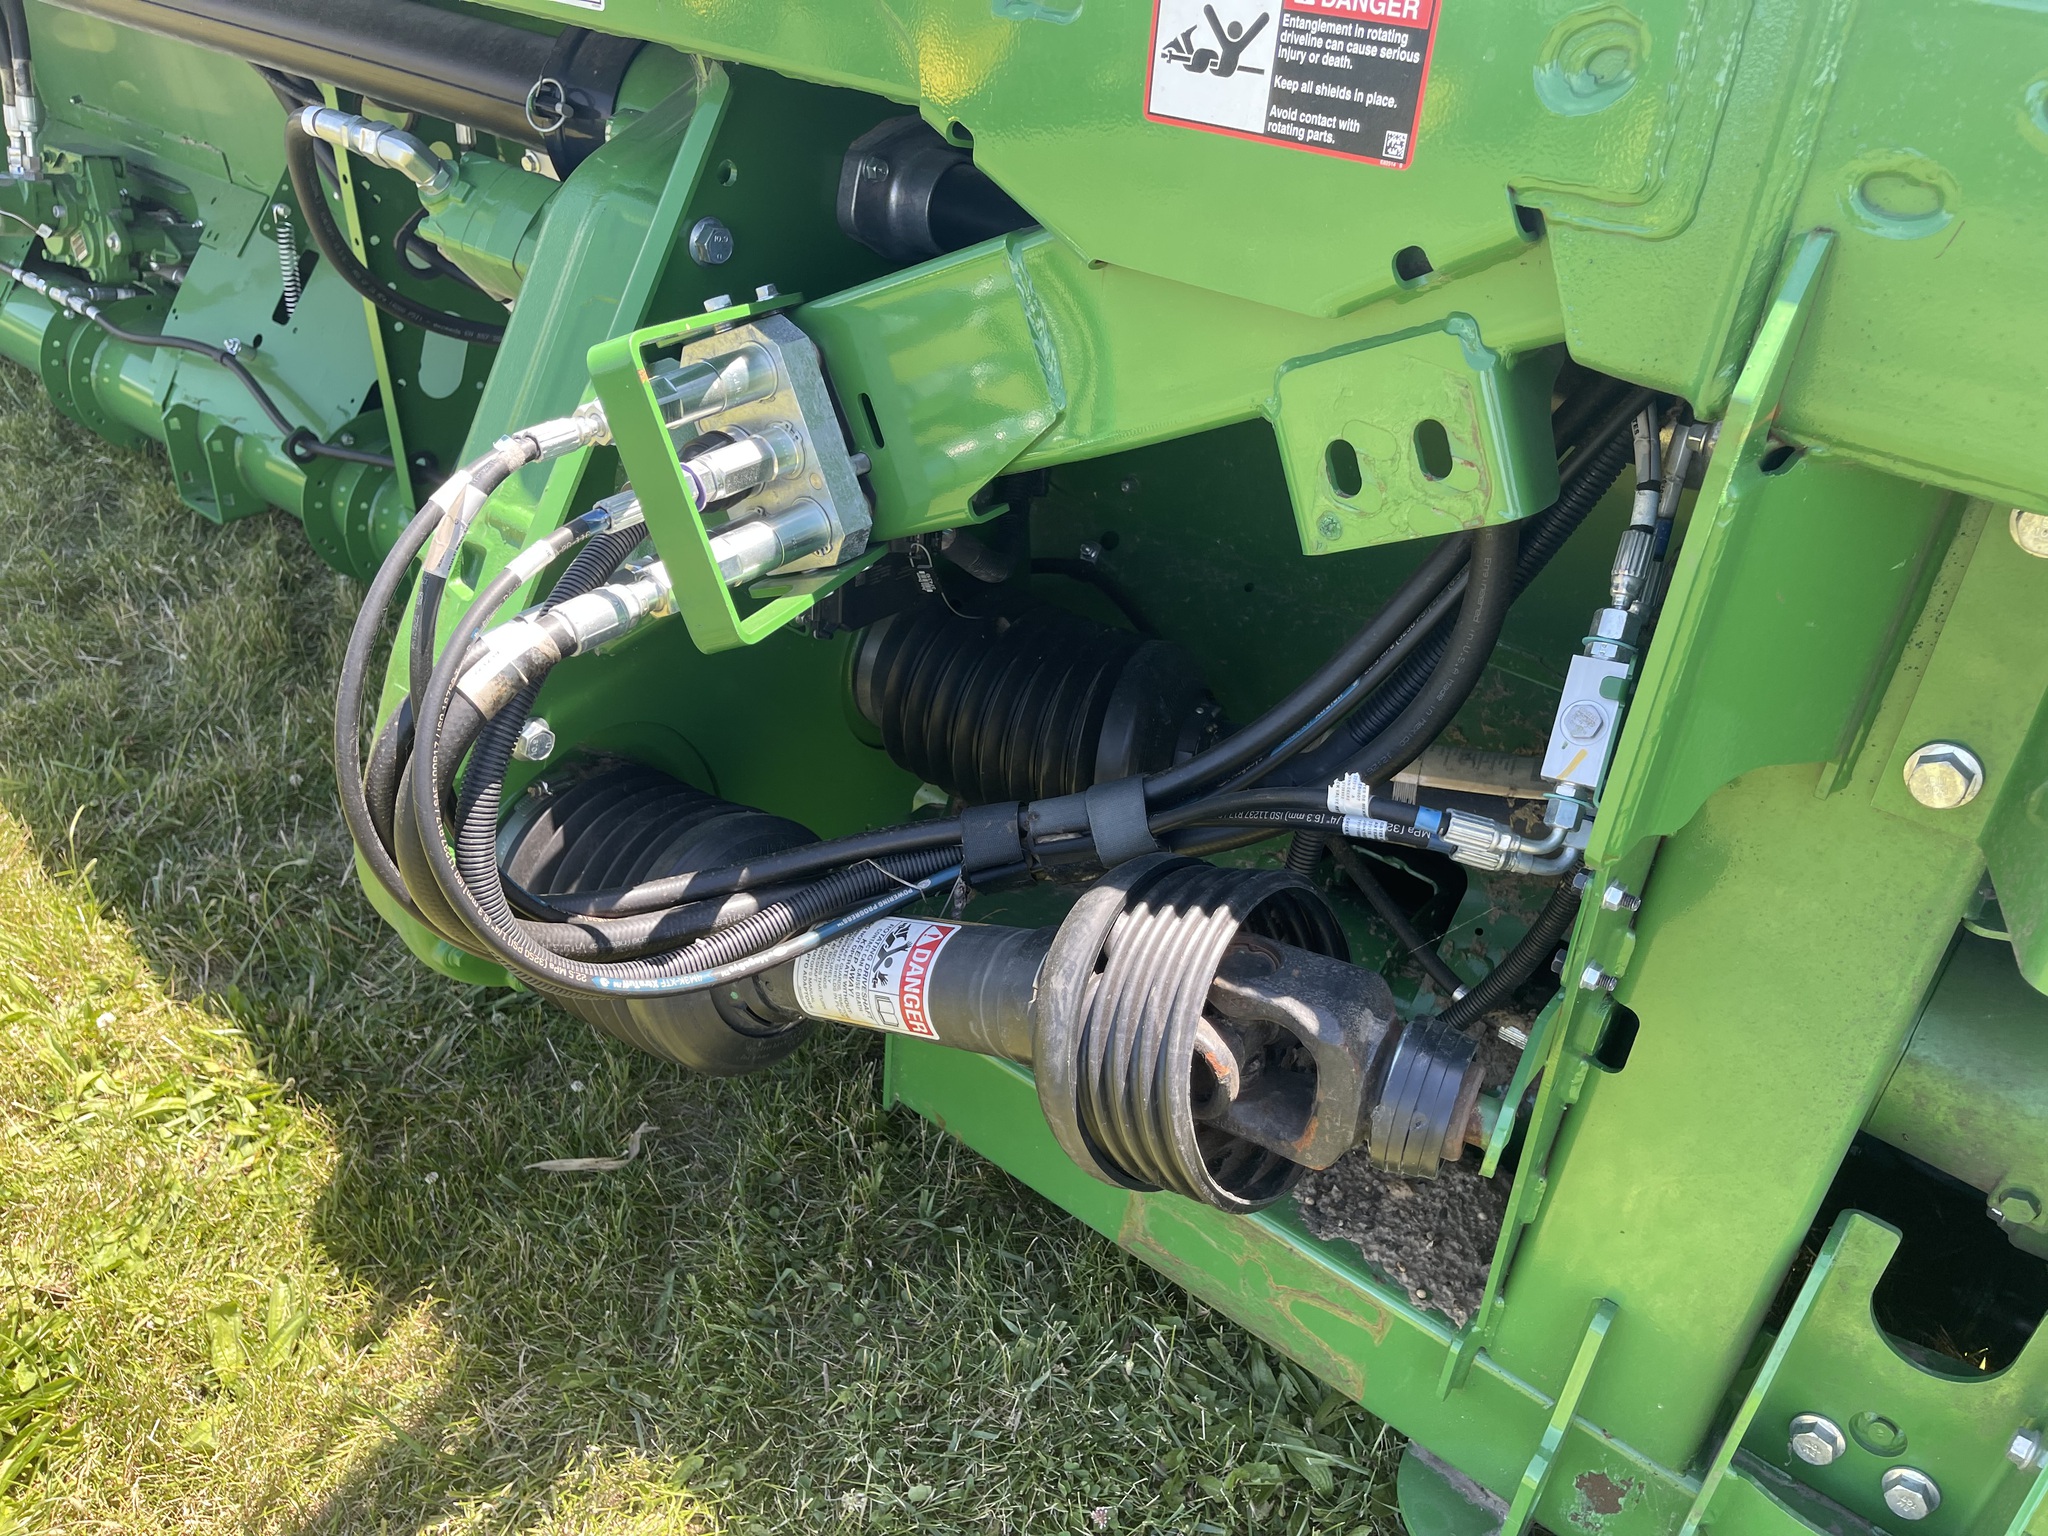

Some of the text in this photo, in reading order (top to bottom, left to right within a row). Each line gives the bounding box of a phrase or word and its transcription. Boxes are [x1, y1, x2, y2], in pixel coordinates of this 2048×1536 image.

[1282, 13, 1409, 48] Entanglement in rotating
[1278, 45, 1353, 70] injury or death.
[1280, 30, 1420, 64] driveline can cause serious
[1273, 75, 1398, 109] Keep all shields in place.
[1269, 104, 1361, 134] Avoid contact with
[1267, 121, 1336, 144] rotating parts.
[1244, 811, 1268, 820] 11237
[1270, 811, 1284, 820] ISO
[1407, 825, 1431, 839] MPa
[454, 870, 465, 888] ISO
[878, 887, 914, 907] POWERING
[856, 931, 866, 944] NOT
[865, 928, 883, 953] CONTACT
[525, 950, 548, 969] (3250
[549, 962, 568, 977] MPa
[844, 944, 857, 978] OPERATE
[848, 938, 867, 998] KEEP AWAY!
[859, 953, 867, 967] CAN
[861, 923, 894, 1019] ROTATING DRIVESHAFT
[569, 973, 587, 982] 22.5
[903, 948, 932, 1034] DANGER
